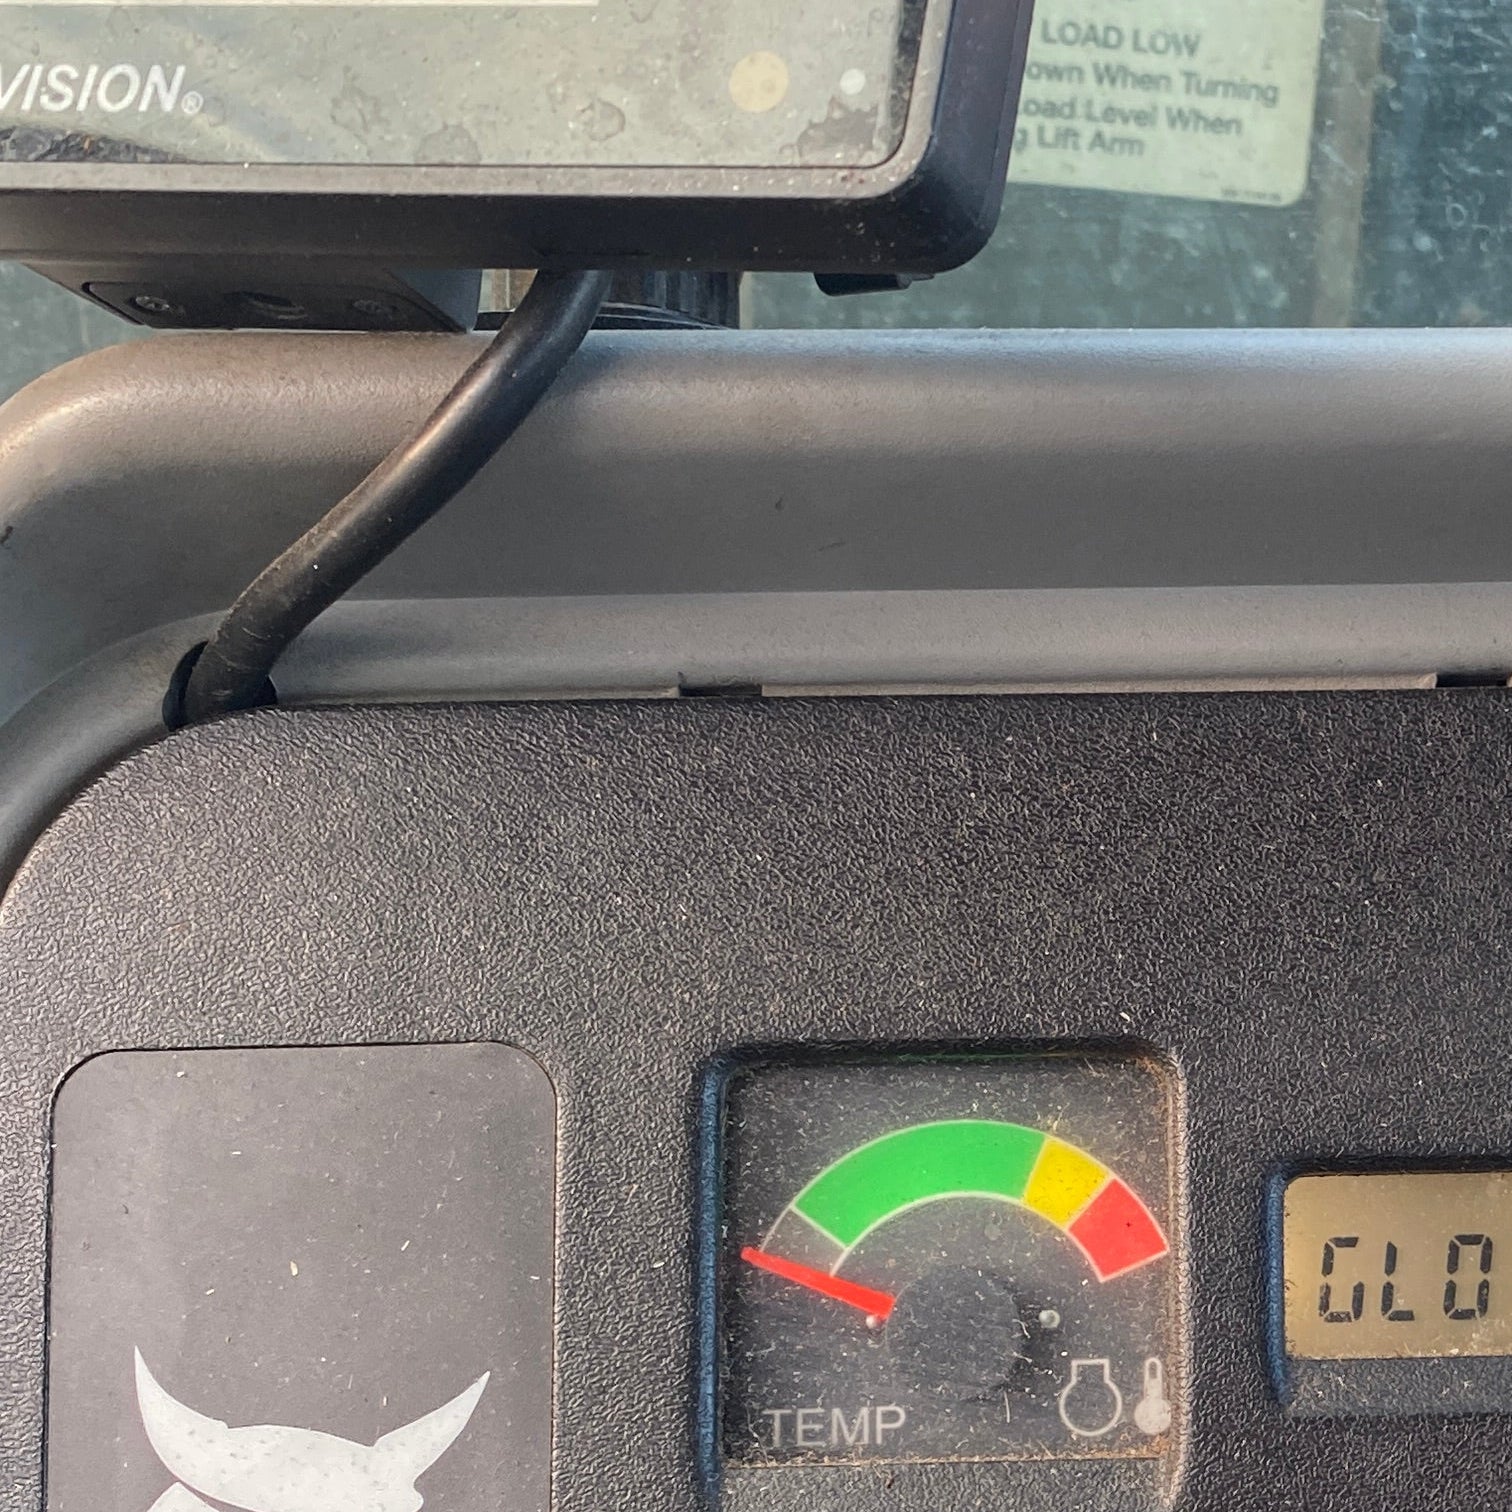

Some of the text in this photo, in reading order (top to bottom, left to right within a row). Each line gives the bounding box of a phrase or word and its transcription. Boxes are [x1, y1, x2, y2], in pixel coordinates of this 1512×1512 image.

[1041, 19, 1202, 57] LOAD LOW
[1025, 61, 1280, 108] own When Turning
[1021, 96, 1243, 136] oad Level When
[1037, 125, 1083, 151] Lift
[1089, 130, 1145, 156] Arm
[763, 1406, 907, 1448] TEMP
